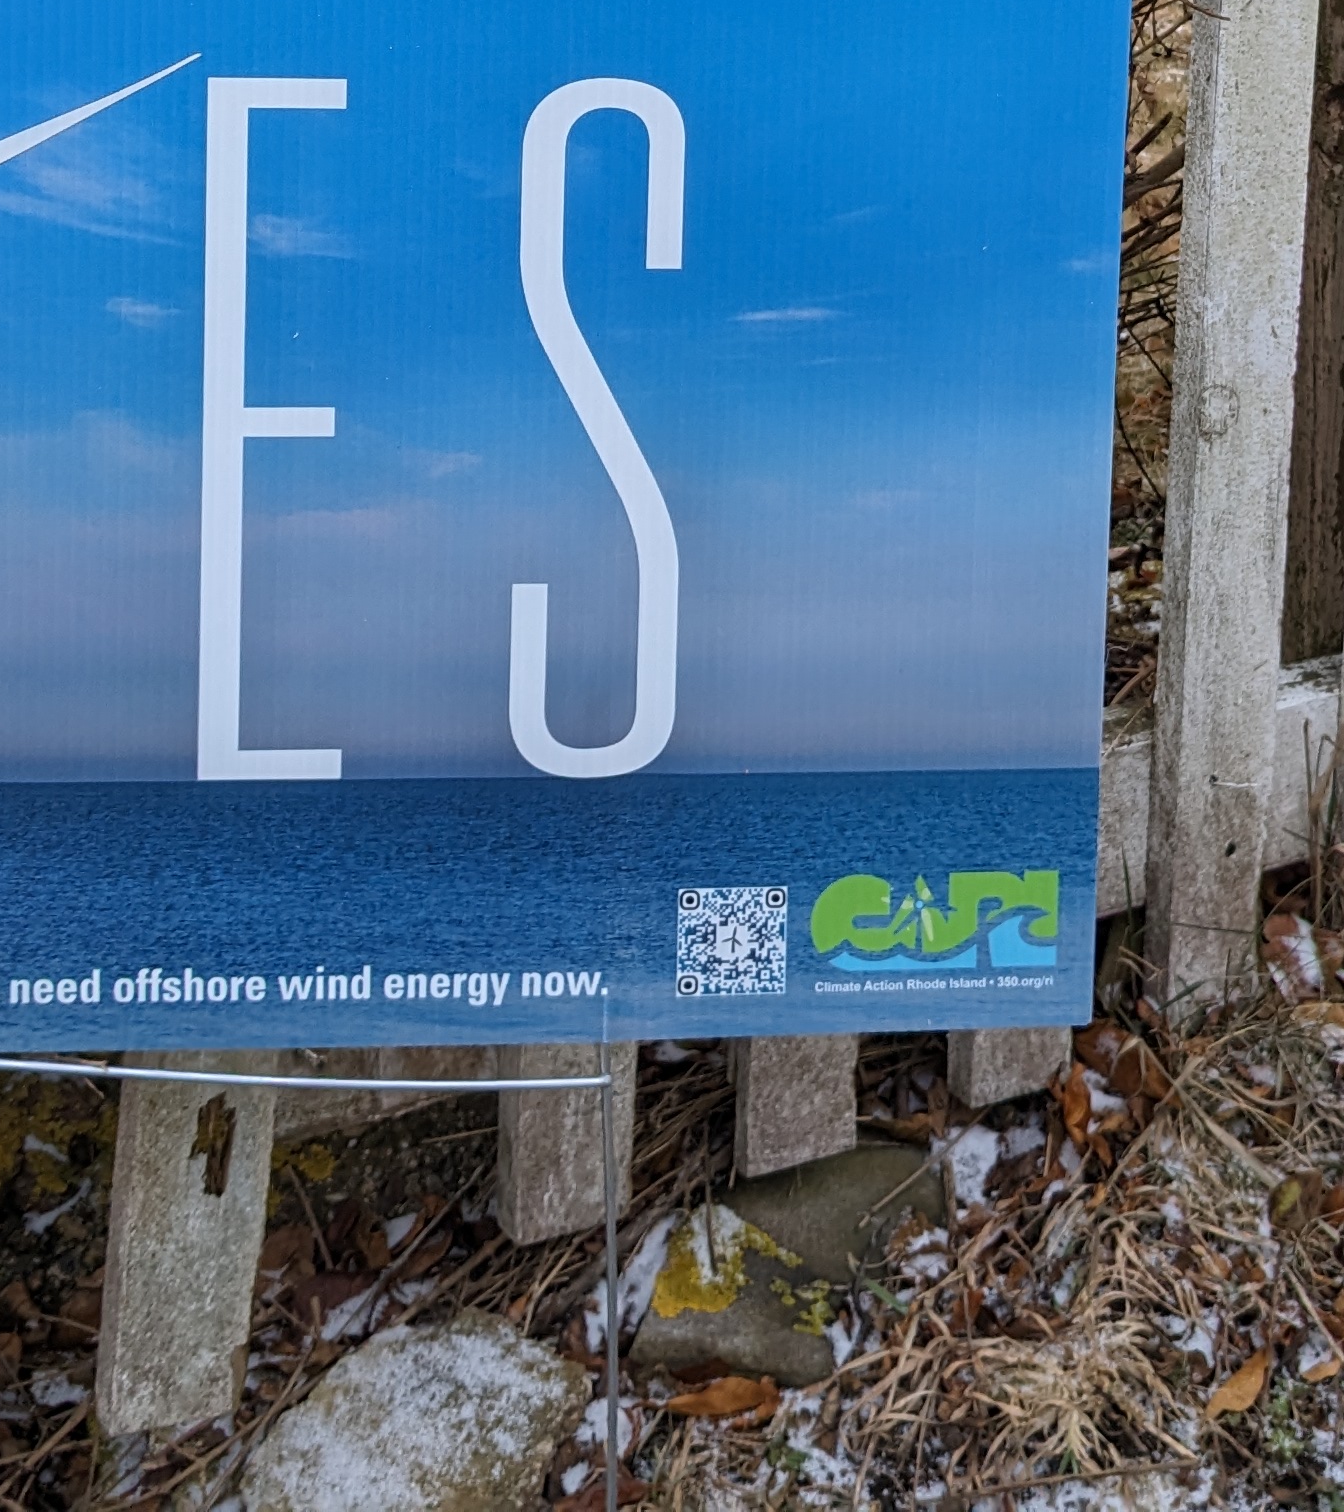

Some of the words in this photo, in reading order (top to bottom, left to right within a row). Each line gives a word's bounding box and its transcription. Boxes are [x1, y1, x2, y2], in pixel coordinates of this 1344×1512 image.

[8, 969, 102, 1005] need
[112, 967, 267, 1003] offshore
[277, 965, 372, 1001] wind
[383, 971, 511, 1006] energy
[520, 970, 609, 997] now.
[814, 981, 861, 993] Climate
[863, 979, 904, 991] Action
[906, 978, 947, 990] Rhode
[948, 976, 987, 989] Island
[997, 975, 1054, 989] 350.org/ri
